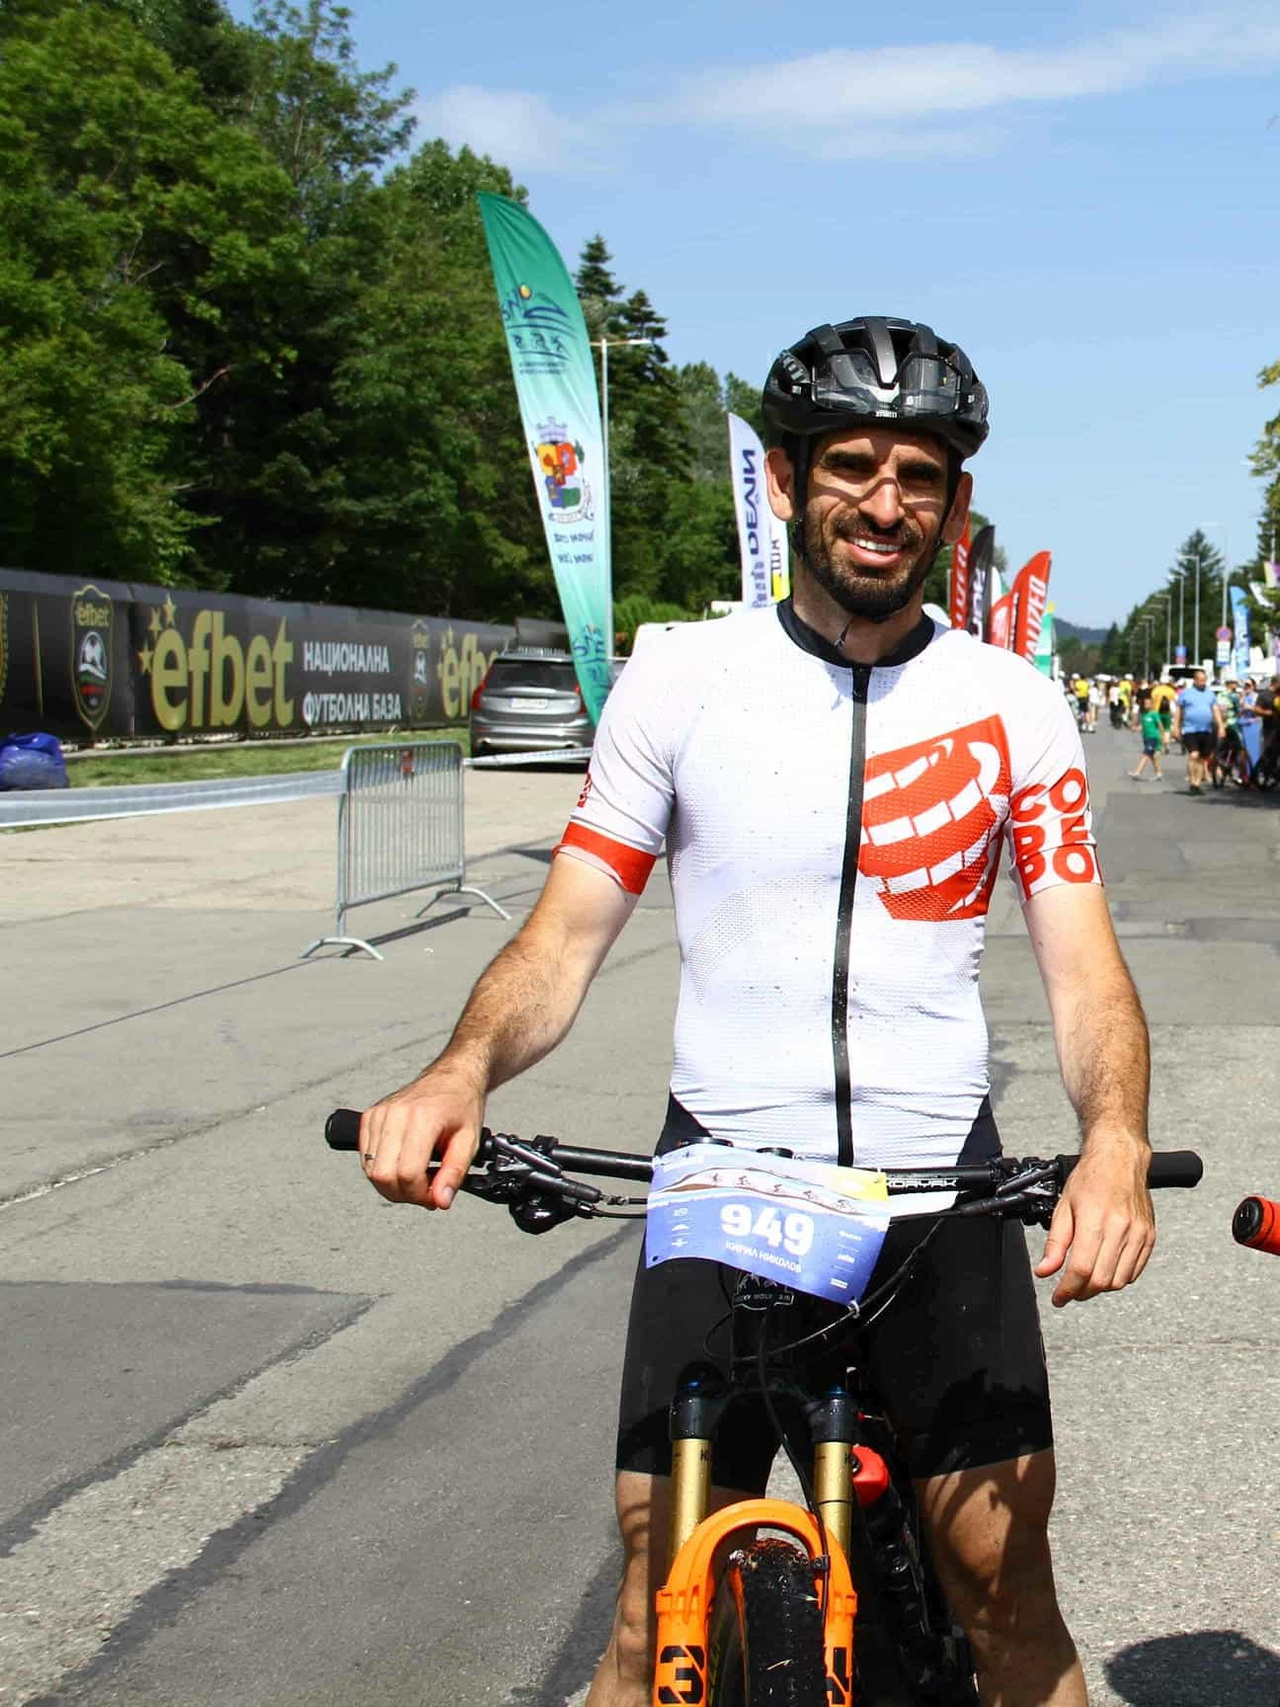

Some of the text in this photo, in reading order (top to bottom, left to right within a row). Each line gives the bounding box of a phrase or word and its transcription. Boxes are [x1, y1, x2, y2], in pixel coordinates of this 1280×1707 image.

[152, 611, 294, 732] efbet
[303, 640, 390, 677] НАЦИОНАЛНА
[443, 633, 500, 719] efb
[302, 691, 402, 726] ФУТБОЛНА БАЗА
[720, 1203, 815, 1257] 949
